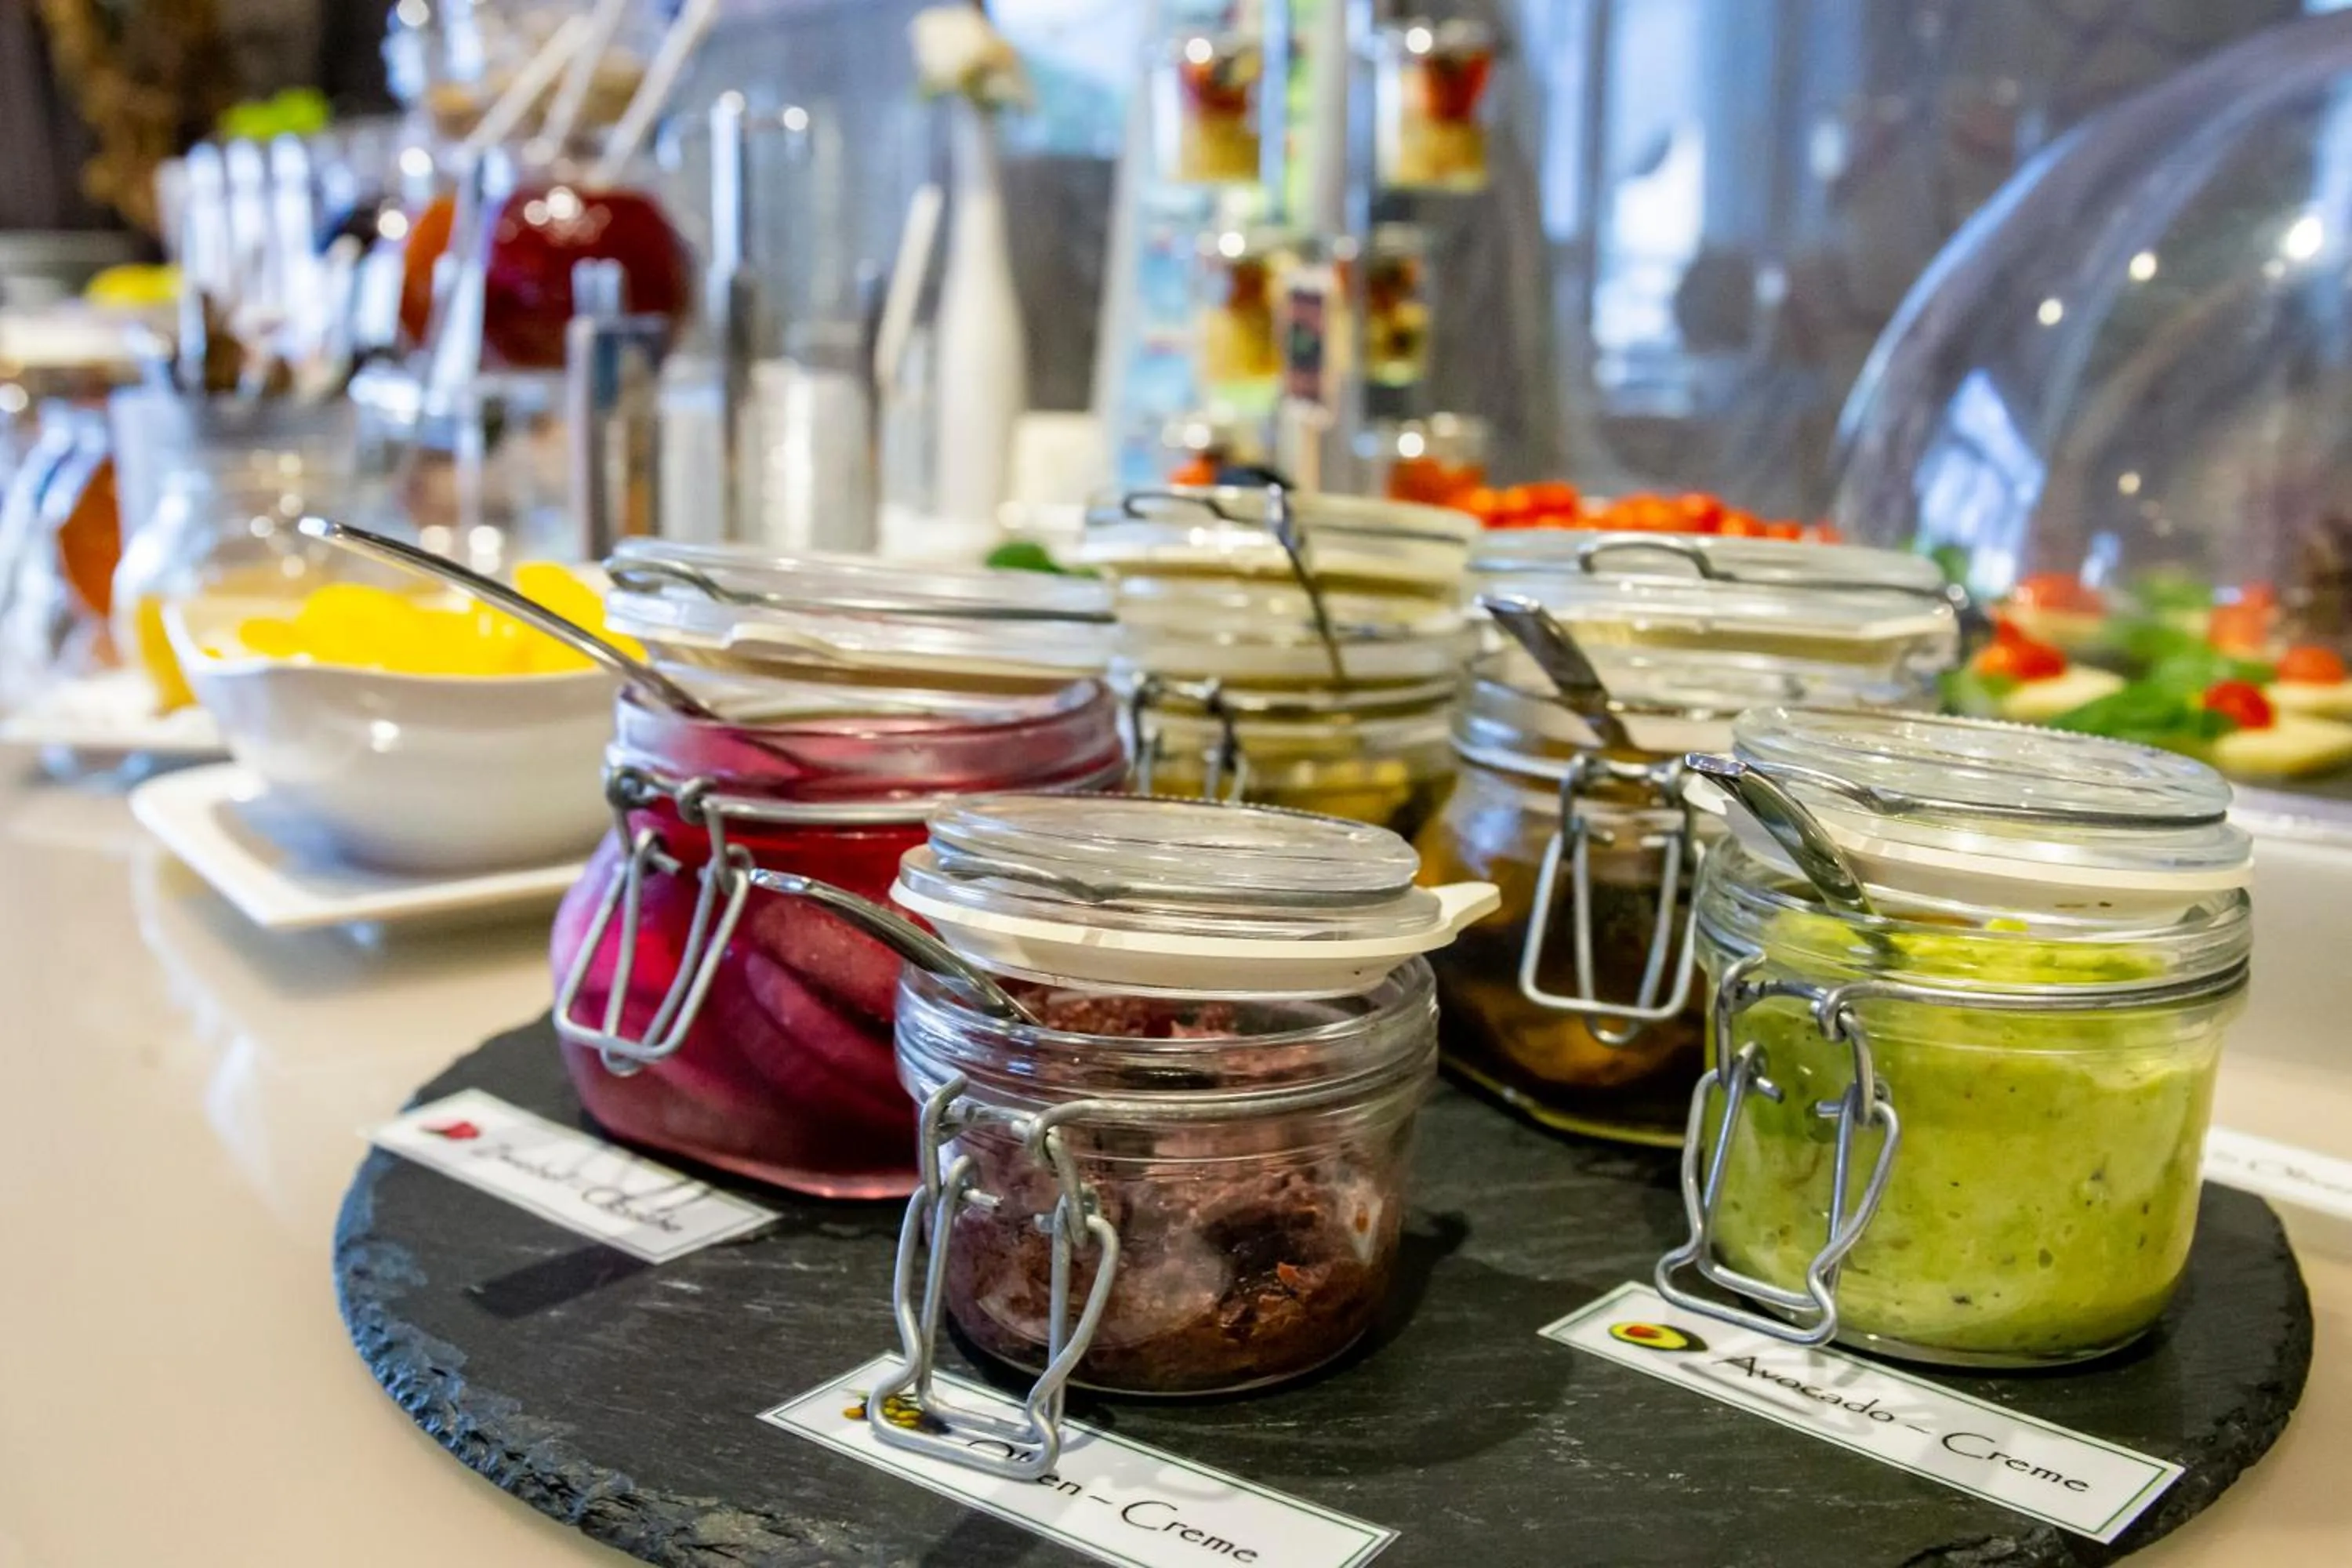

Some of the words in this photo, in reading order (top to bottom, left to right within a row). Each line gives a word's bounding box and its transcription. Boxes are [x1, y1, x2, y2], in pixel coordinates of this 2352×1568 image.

[1711, 1356, 1896, 1424] Avocado
[1941, 1432, 2091, 1493] Creme
[1120, 1500, 1259, 1564] Creme
